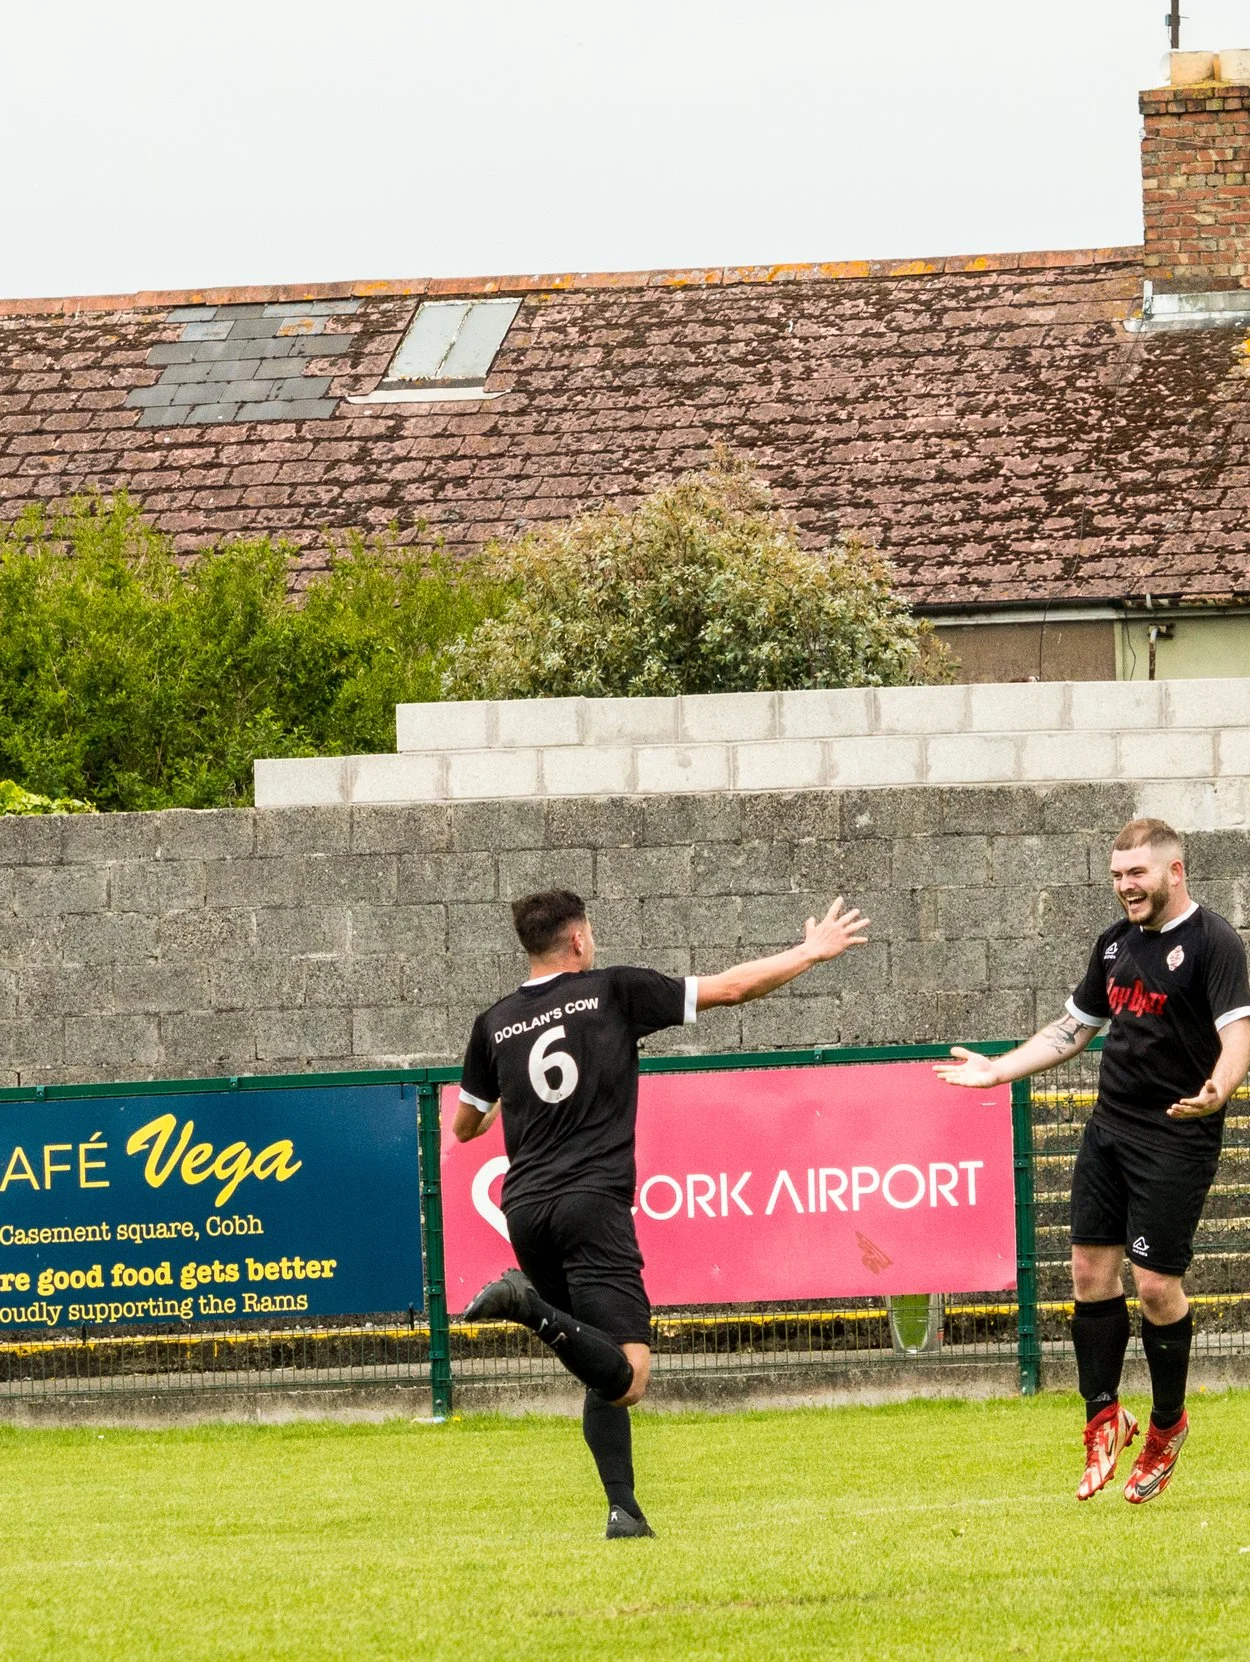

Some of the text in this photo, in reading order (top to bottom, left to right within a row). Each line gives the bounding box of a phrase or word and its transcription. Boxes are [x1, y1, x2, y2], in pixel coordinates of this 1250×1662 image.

[494, 997, 599, 1045] DOOLAN'S COW
[525, 1022, 579, 1104] 6
[126, 1113, 303, 1208] Vega
[630, 1160, 984, 1221] ORK AIRPORT
[0, 1215, 264, 1246] Casement square, Cobh
[37, 1265, 104, 1297] good
[110, 1261, 173, 1287] food
[180, 1259, 240, 1290] gets
[244, 1256, 338, 1281] better
[68, 1297, 194, 1324] supporting
[198, 1294, 237, 1315] the
[241, 1292, 309, 1313] Rams
